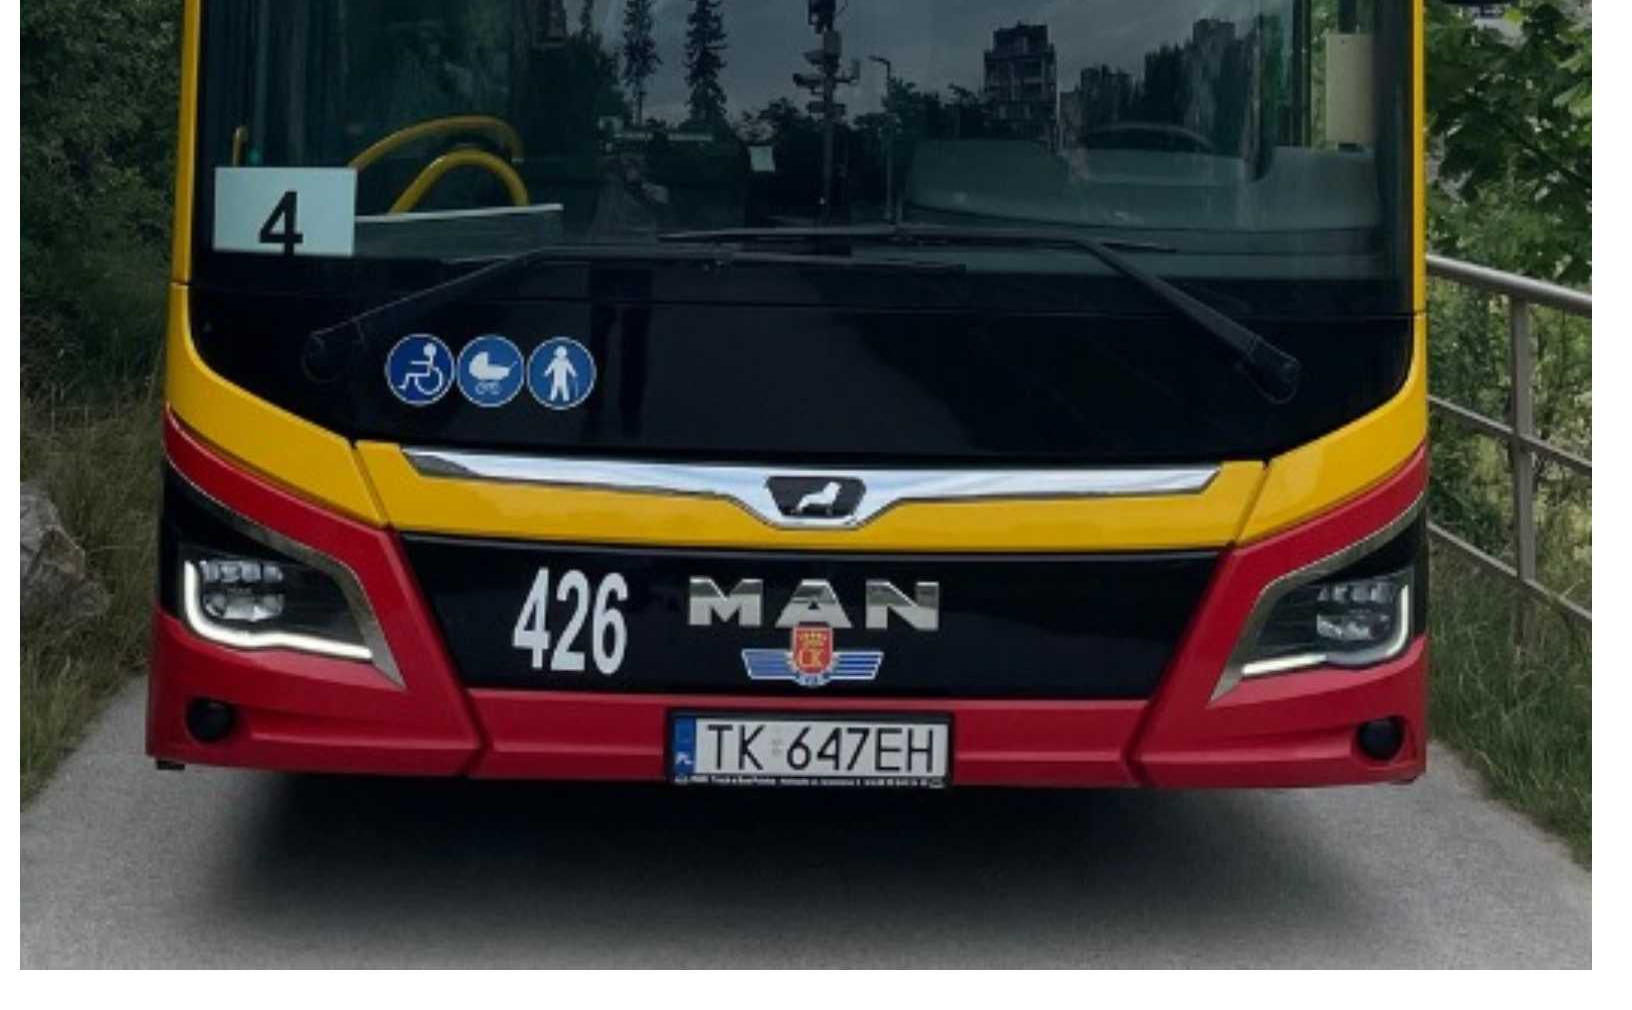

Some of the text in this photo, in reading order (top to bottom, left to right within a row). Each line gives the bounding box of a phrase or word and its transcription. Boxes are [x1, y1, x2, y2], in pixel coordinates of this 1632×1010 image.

[259, 190, 304, 256] 4
[512, 567, 629, 675] 426
[688, 576, 940, 631] MAN
[707, 724, 934, 773] TK 647EH
